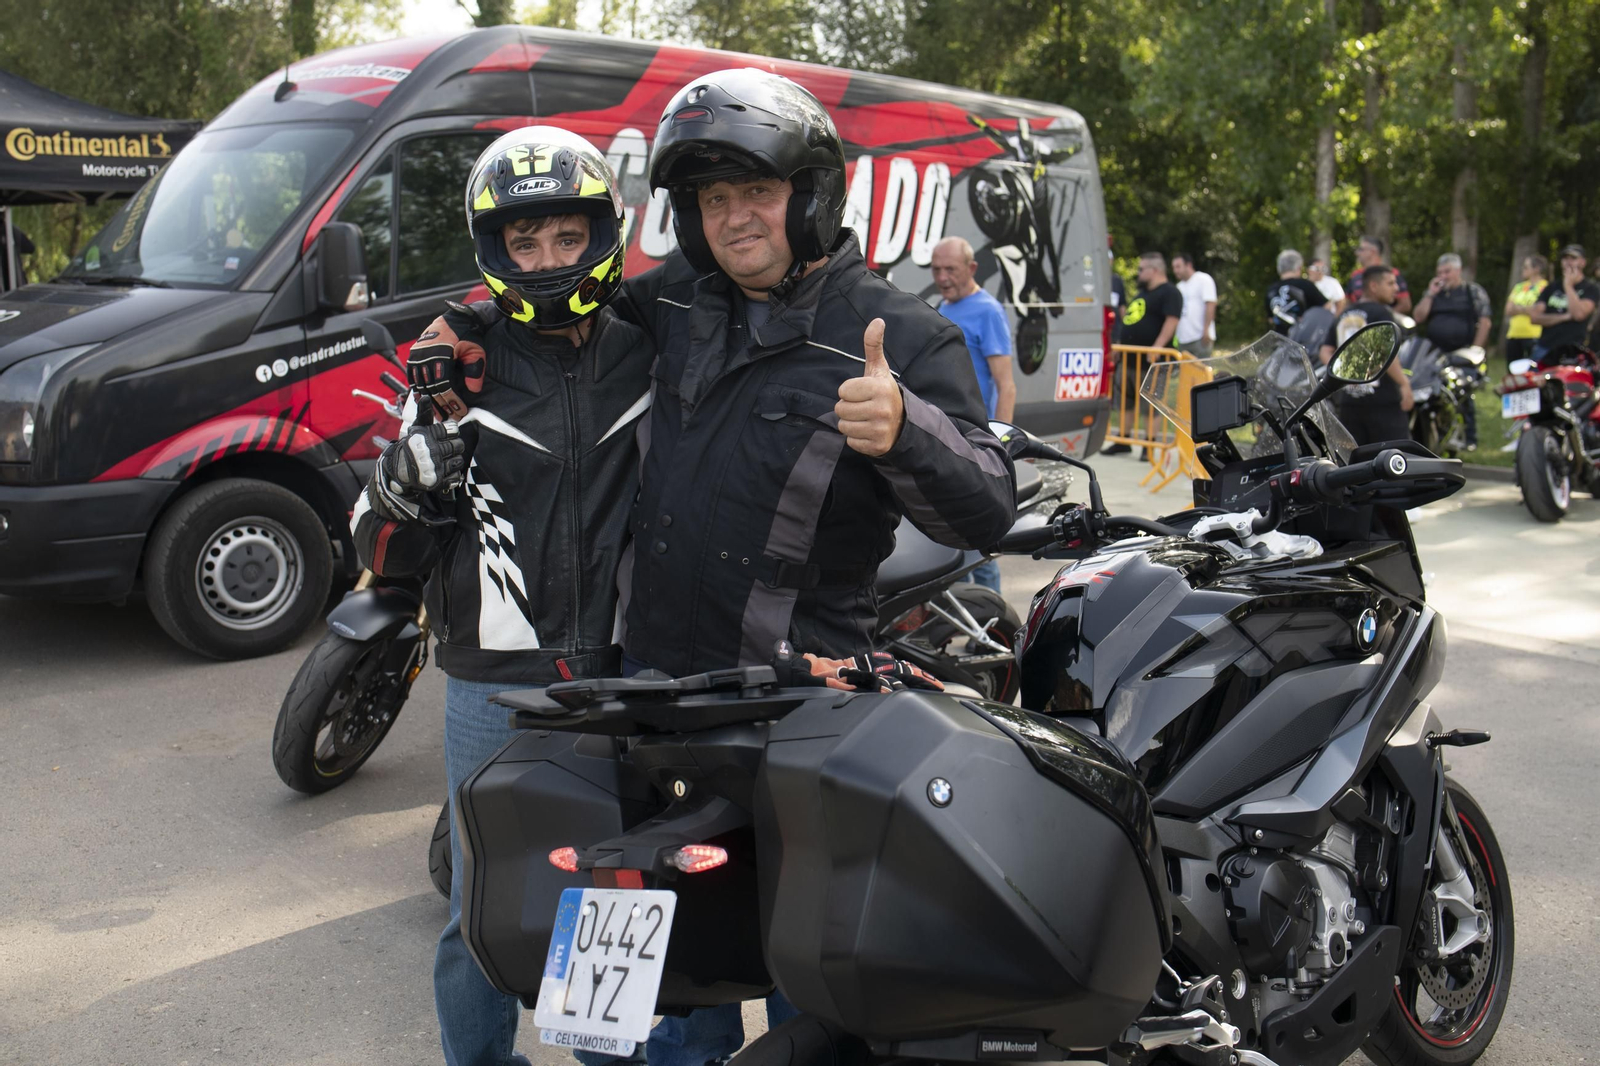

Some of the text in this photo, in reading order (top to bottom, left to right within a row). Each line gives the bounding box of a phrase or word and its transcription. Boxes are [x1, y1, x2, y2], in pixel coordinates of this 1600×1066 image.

[5, 127, 150, 161] Continental
[82, 163, 147, 178] Motorcycle
[517, 179, 552, 193] HJC
[606, 128, 951, 266] CUADO
[1061, 353, 1100, 375] LIQUI
[1058, 376, 1098, 398] MOLY
[577, 900, 664, 960] 0442
[553, 944, 565, 964] E
[563, 961, 630, 1023] LYZ
[554, 1031, 618, 1052] CELTAMOTOR
[982, 1040, 1037, 1052] BMW Motorrad
